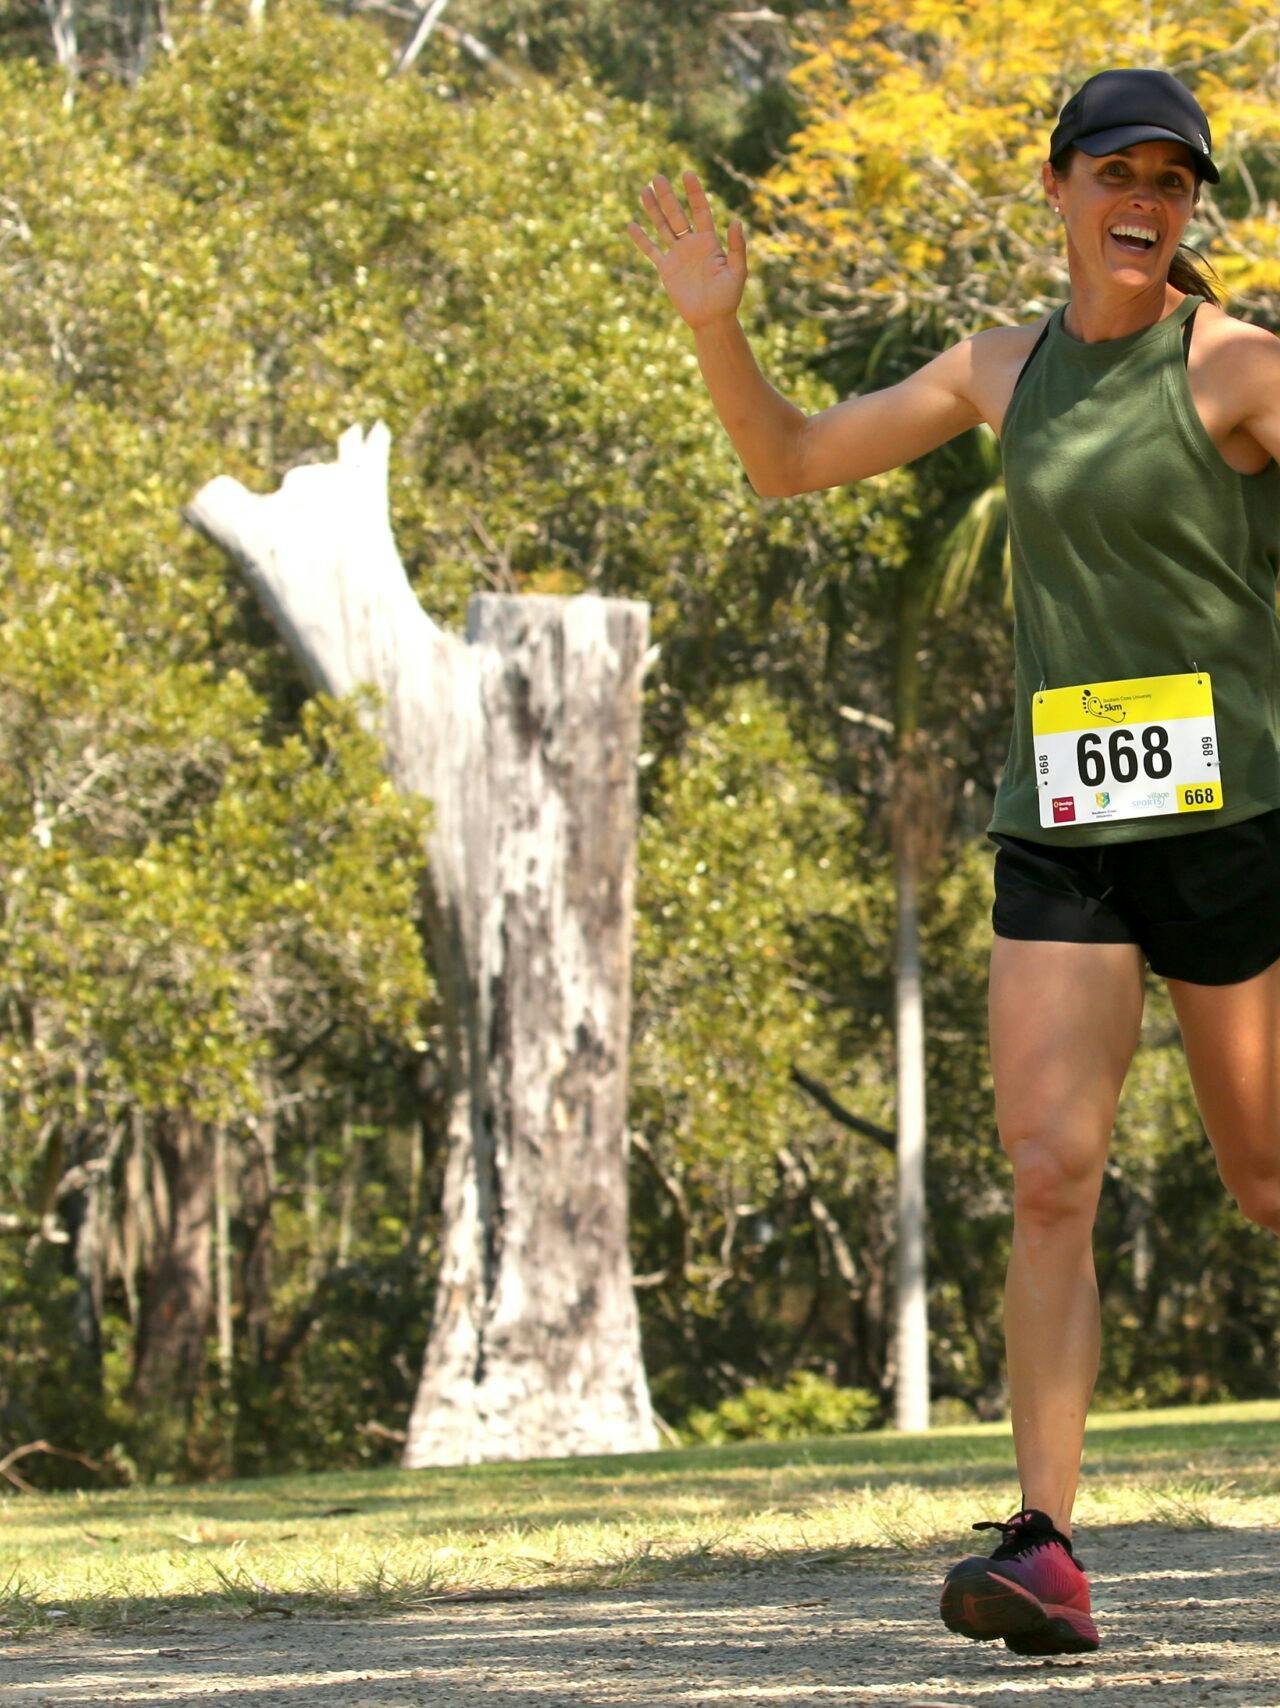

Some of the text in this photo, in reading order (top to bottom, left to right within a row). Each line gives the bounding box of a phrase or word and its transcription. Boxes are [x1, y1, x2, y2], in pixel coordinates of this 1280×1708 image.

[1104, 703, 1122, 712] 5km
[1076, 725, 1173, 788] 668
[1201, 736, 1214, 757] 668
[1038, 754, 1050, 775] 668
[1184, 788, 1215, 806] 668
